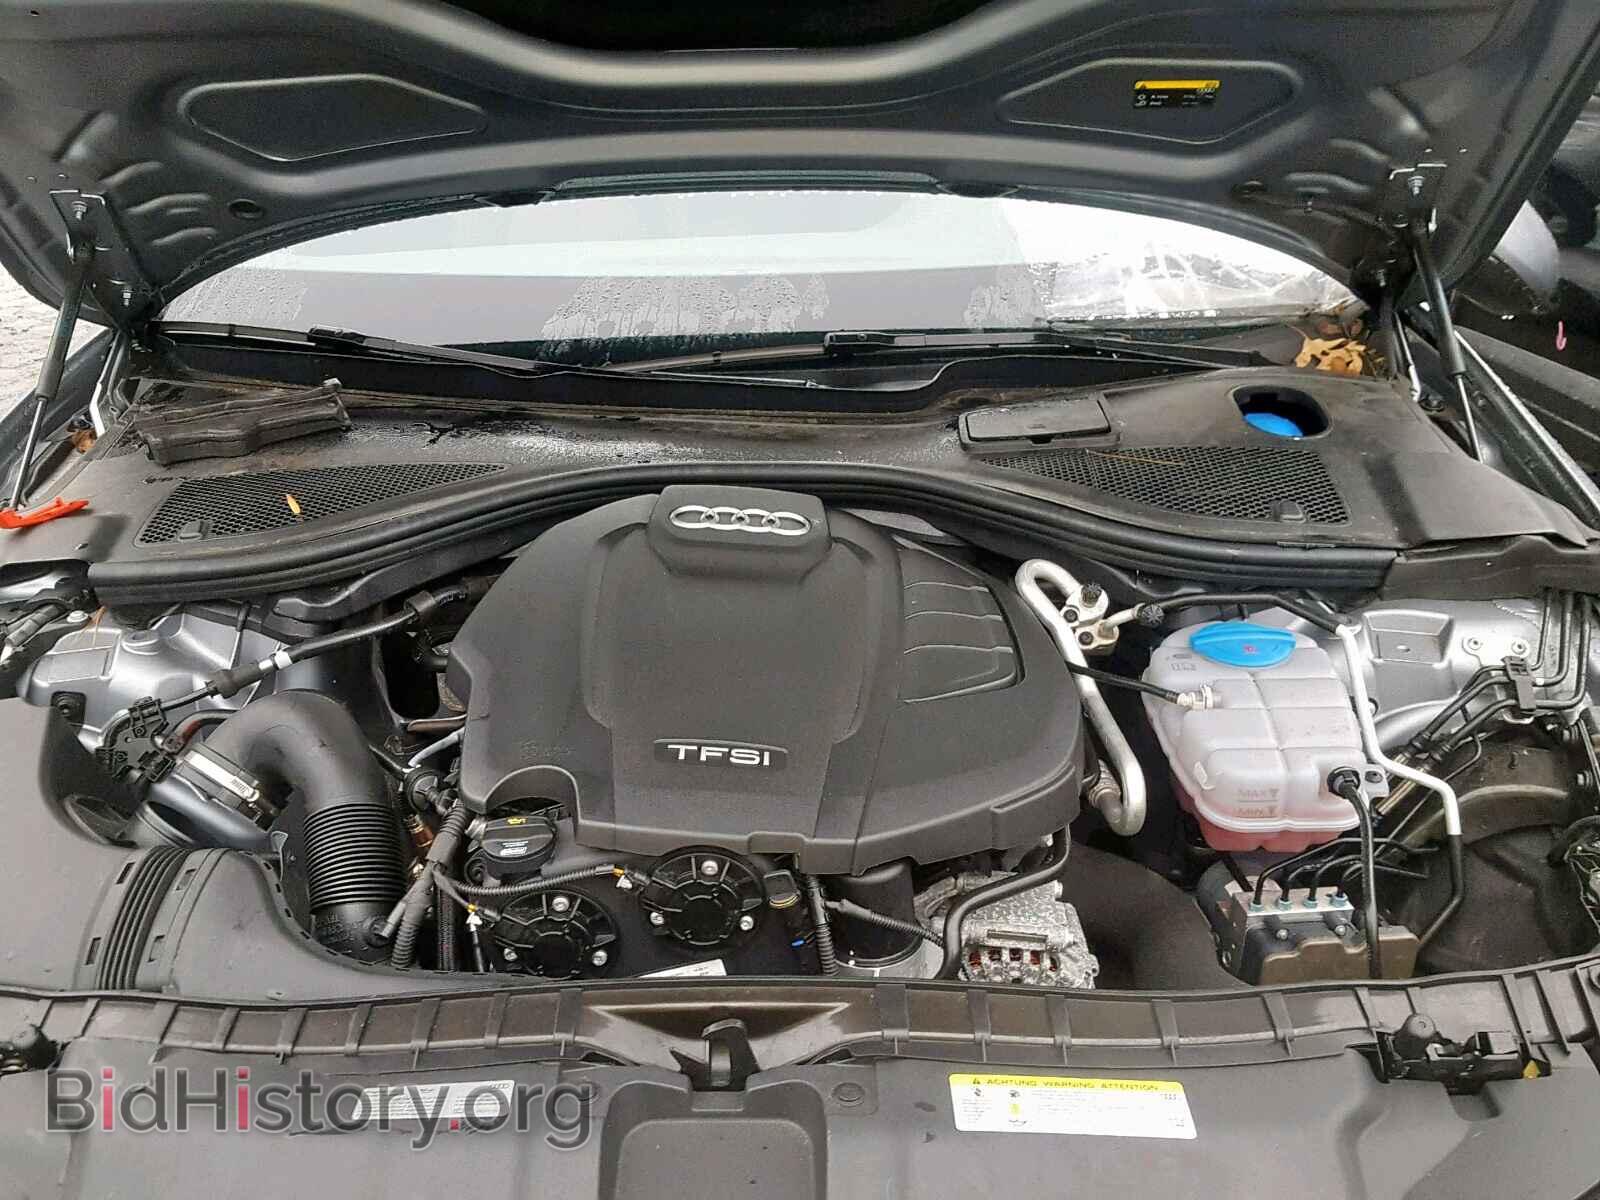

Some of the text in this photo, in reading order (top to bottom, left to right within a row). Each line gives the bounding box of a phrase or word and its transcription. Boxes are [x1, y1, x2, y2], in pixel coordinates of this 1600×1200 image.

[667, 744, 770, 766] TFSI
[986, 1078, 1159, 1091] ACHTUNG WARNING ATTENTION
